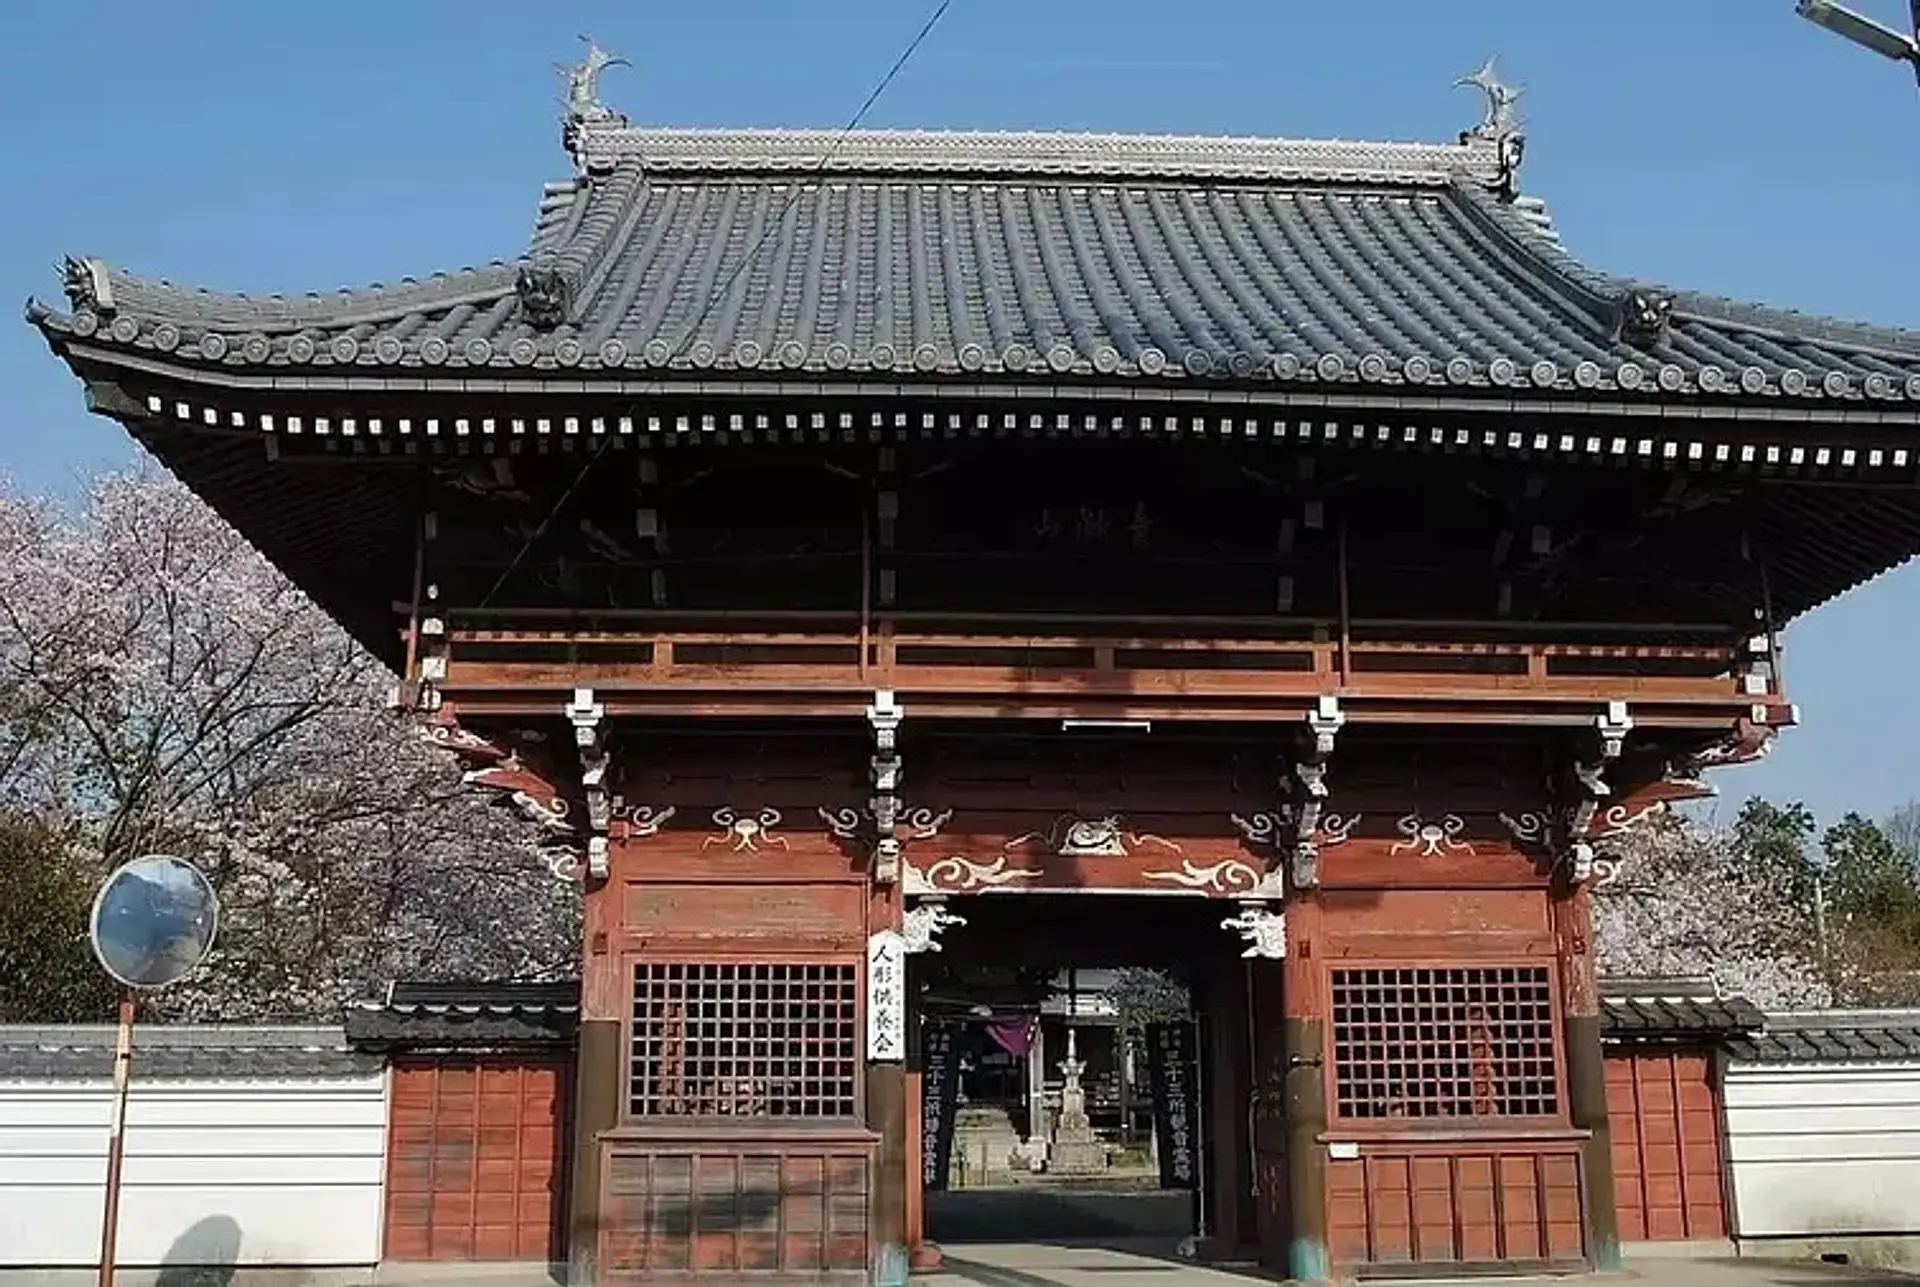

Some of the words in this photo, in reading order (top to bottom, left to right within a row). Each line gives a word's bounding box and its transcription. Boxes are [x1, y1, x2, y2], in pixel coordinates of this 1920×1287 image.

[871, 944, 894, 1053] 人形供養会
